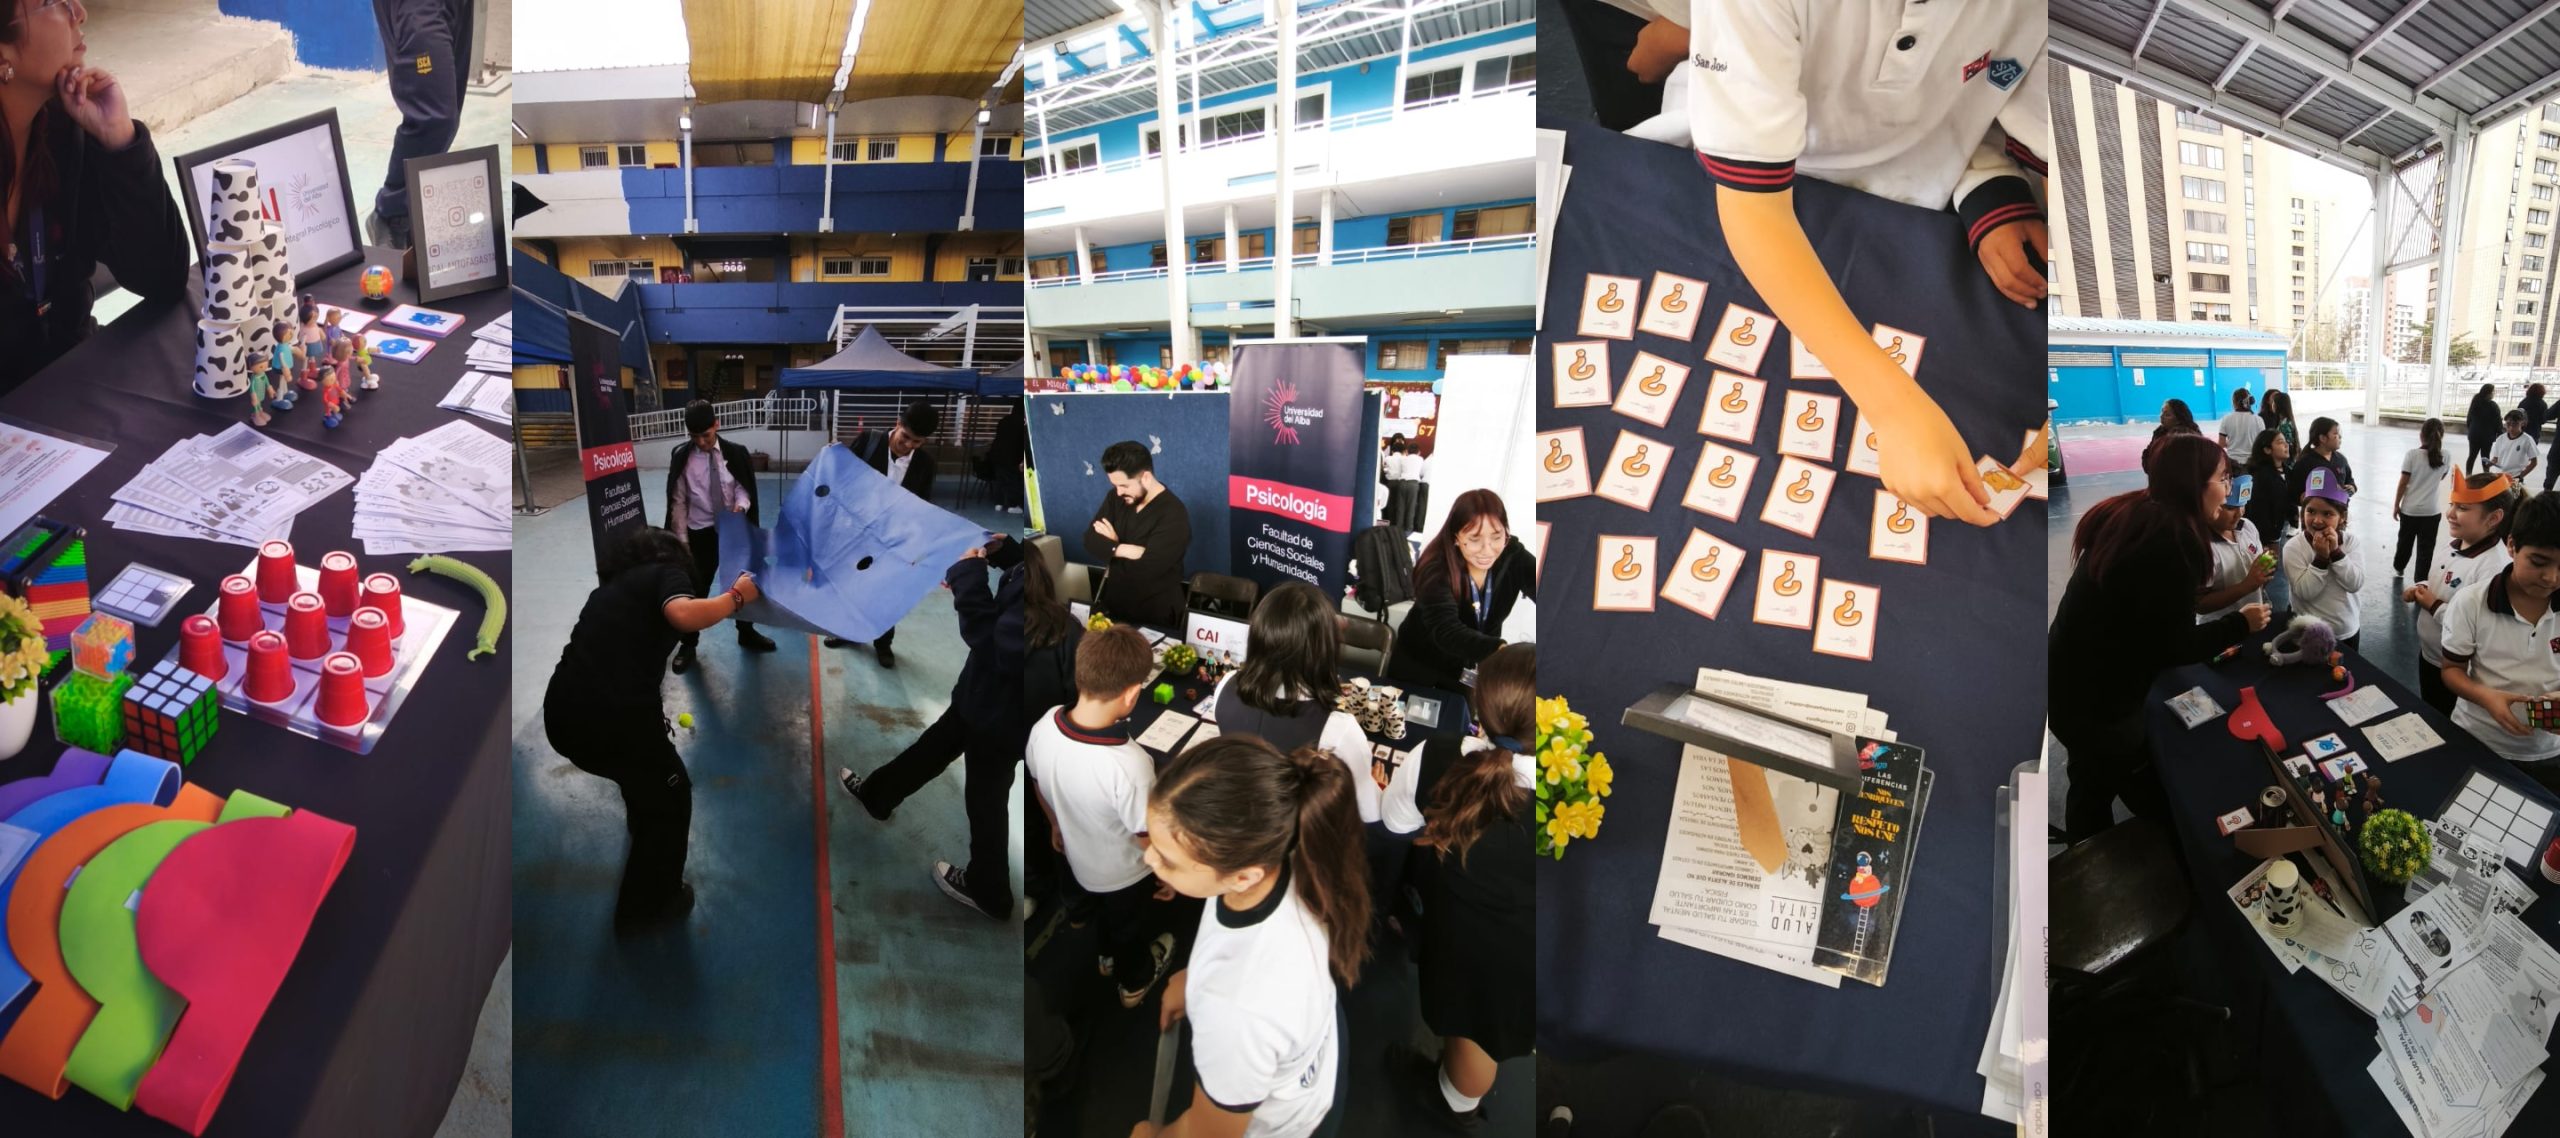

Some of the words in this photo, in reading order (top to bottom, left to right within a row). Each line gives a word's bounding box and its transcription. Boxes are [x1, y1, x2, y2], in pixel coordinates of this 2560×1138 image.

[1695, 53, 1710, 69] San
[1284, 406, 1324, 418] Universidad
[1284, 415, 1293, 424] del
[1294, 416, 1311, 426] Alba
[593, 448, 634, 472] Psicología
[600, 501, 622, 517] Ciencias
[621, 493, 641, 508] Sociales
[1246, 484, 1327, 521] Psicología
[1262, 523, 1300, 546] Facultad
[1301, 535, 1313, 550] de
[1247, 536, 1286, 557] Ciencias
[1286, 548, 1325, 572] Sociales
[1251, 555, 1258, 565] y
[1259, 554, 1320, 586] Humanidades.
[1196, 627, 1219, 643] CAI
[1877, 771, 1891, 780] LAS
[1871, 808, 1882, 820] EL
[1852, 814, 1900, 833] RESPETO
[1853, 823, 1874, 837] NOS
[1876, 829, 1896, 843] UNE
[1707, 876, 1727, 884] ALERTA
[1669, 890, 1693, 901] SALUD
[1694, 894, 1704, 902] TU
[1705, 897, 1734, 906] CUIDAR
[1663, 905, 1691, 917] MENTAL
[1674, 900, 1722, 913] IMPORTANTE
[1722, 907, 1737, 916] TAN
[1734, 901, 1758, 910] COMO
[1769, 899, 1817, 920] ENTAL
[1691, 911, 1716, 921] SALUD
[1739, 909, 1749, 917] ES
[1771, 916, 1813, 935] ALUD
[2398, 1033, 2413, 1060] MENTAL
[2034, 1081, 2044, 1135] calmado
